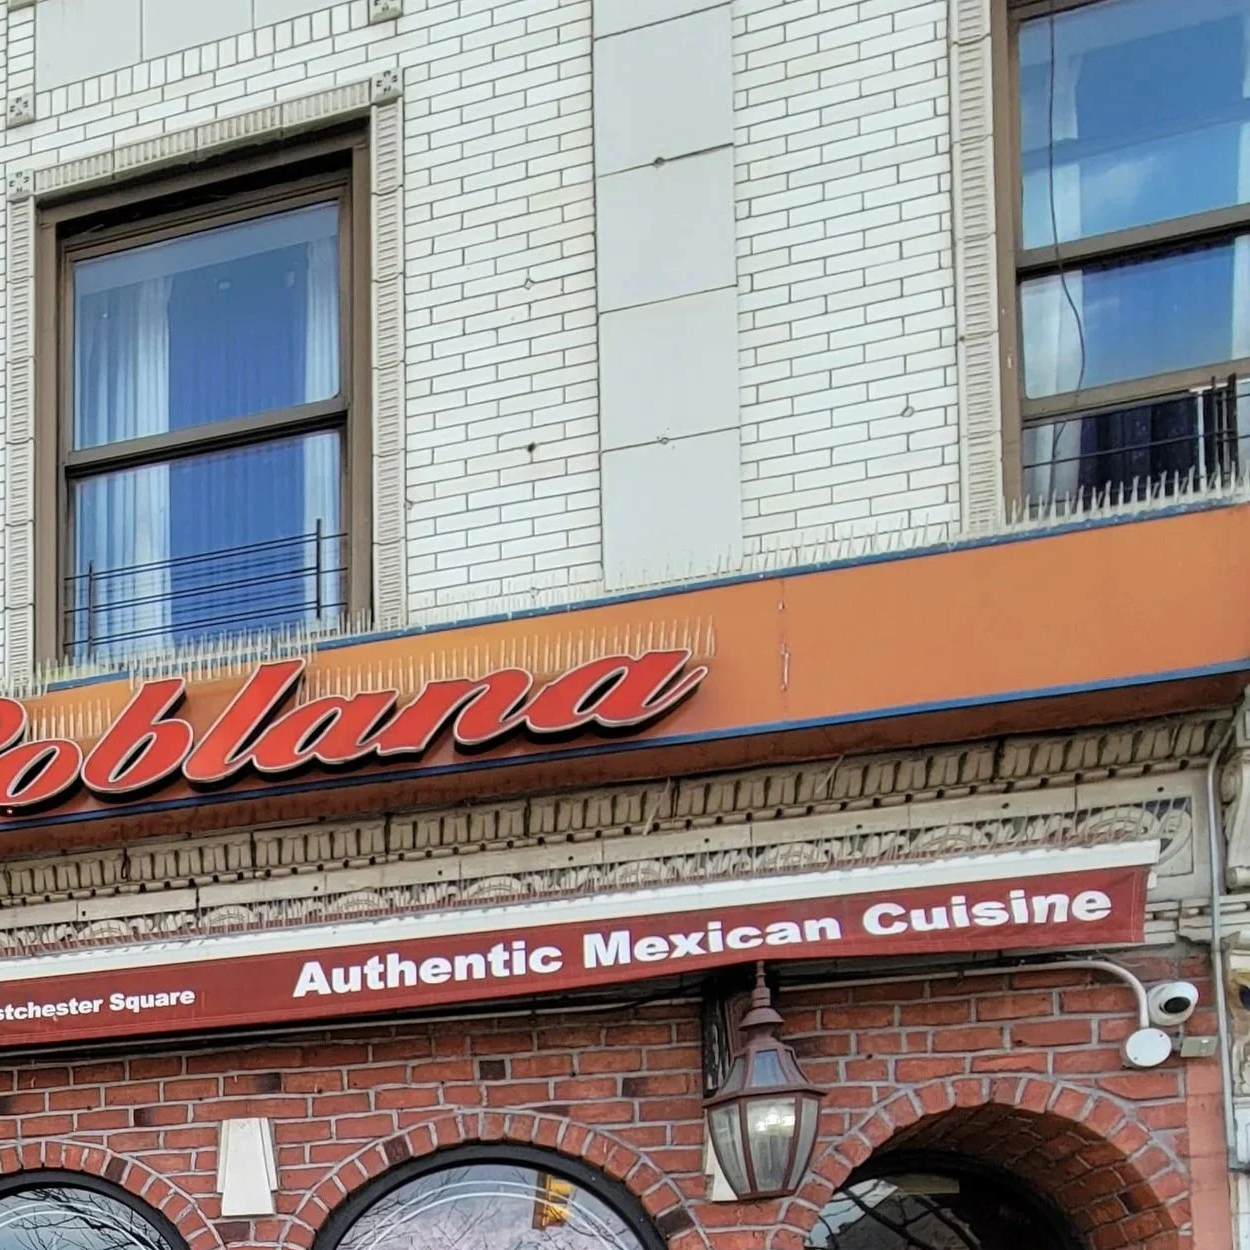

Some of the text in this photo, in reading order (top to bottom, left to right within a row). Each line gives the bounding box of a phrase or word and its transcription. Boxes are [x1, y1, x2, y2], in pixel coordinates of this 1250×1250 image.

[108, 987, 196, 1012] Square
[292, 936, 563, 999] Authentic
[583, 916, 843, 969] Mexican
[863, 888, 1113, 936] Cuisine
